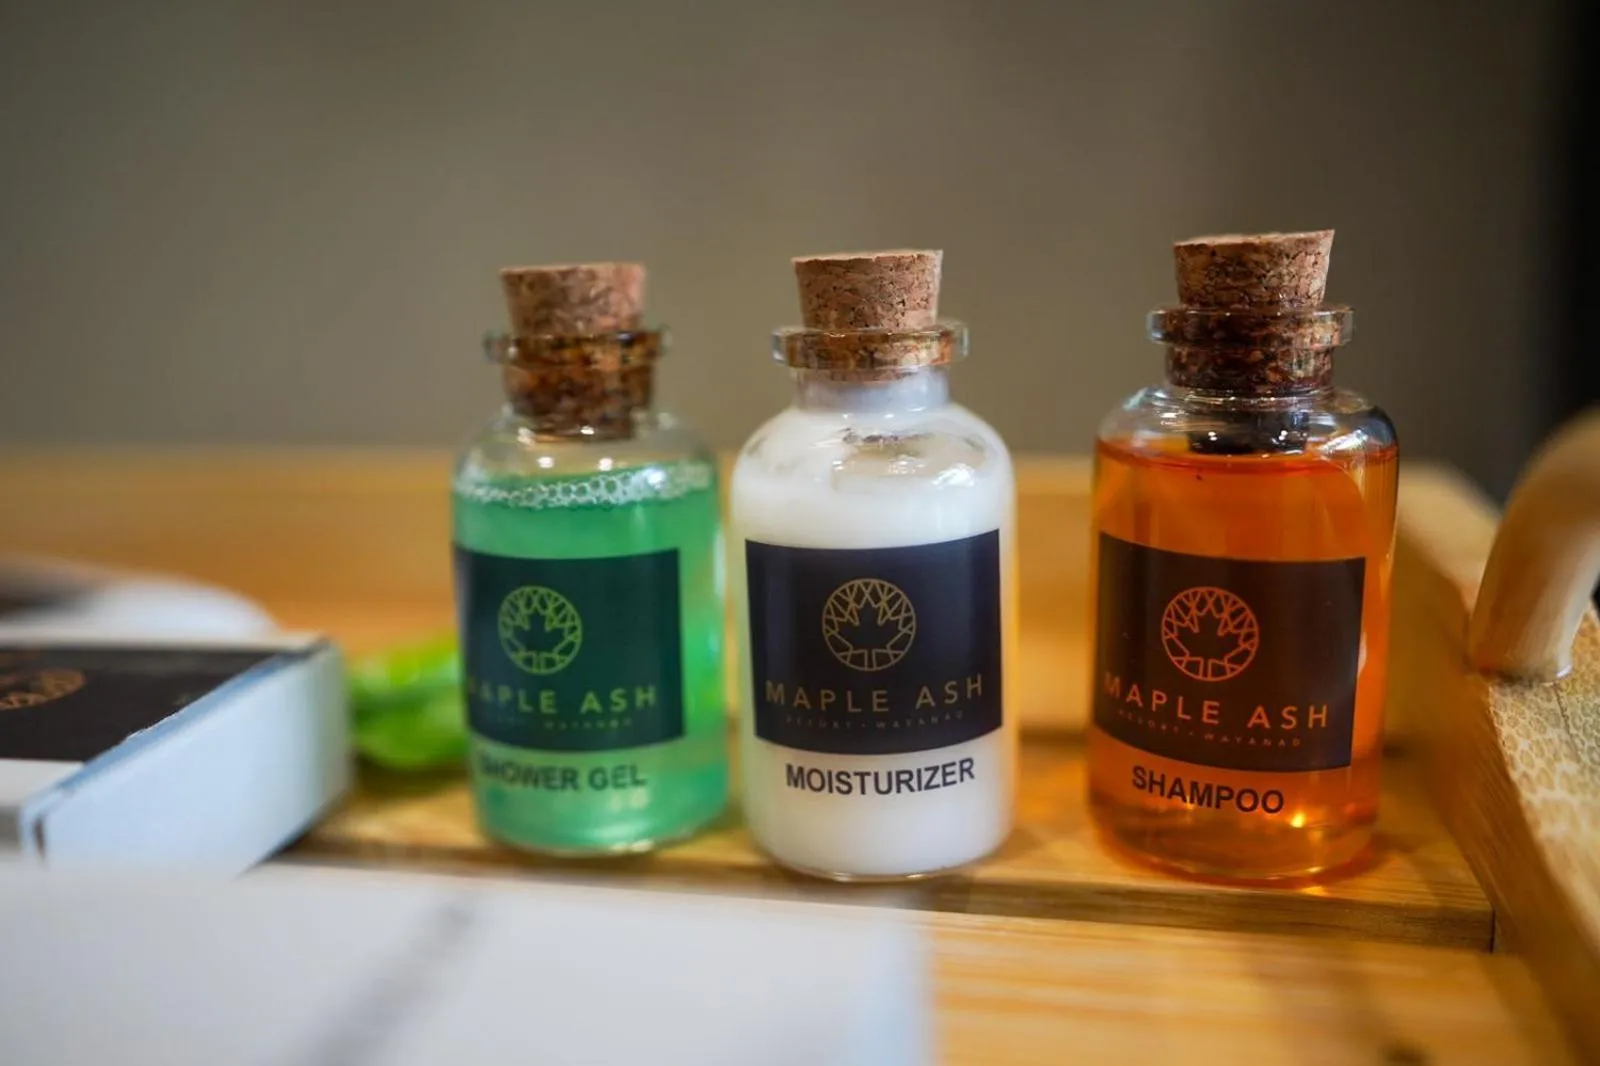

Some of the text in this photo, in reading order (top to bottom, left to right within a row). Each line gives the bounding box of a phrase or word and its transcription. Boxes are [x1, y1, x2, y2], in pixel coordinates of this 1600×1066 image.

[580, 685, 656, 714] ASH
[766, 674, 983, 713] MAPLE ASH
[1104, 671, 1328, 730] MAPLE ASH
[588, 765, 646, 791] GEL
[786, 757, 975, 795] MOISTURIZER
[1132, 765, 1285, 814] SHAMPOO
